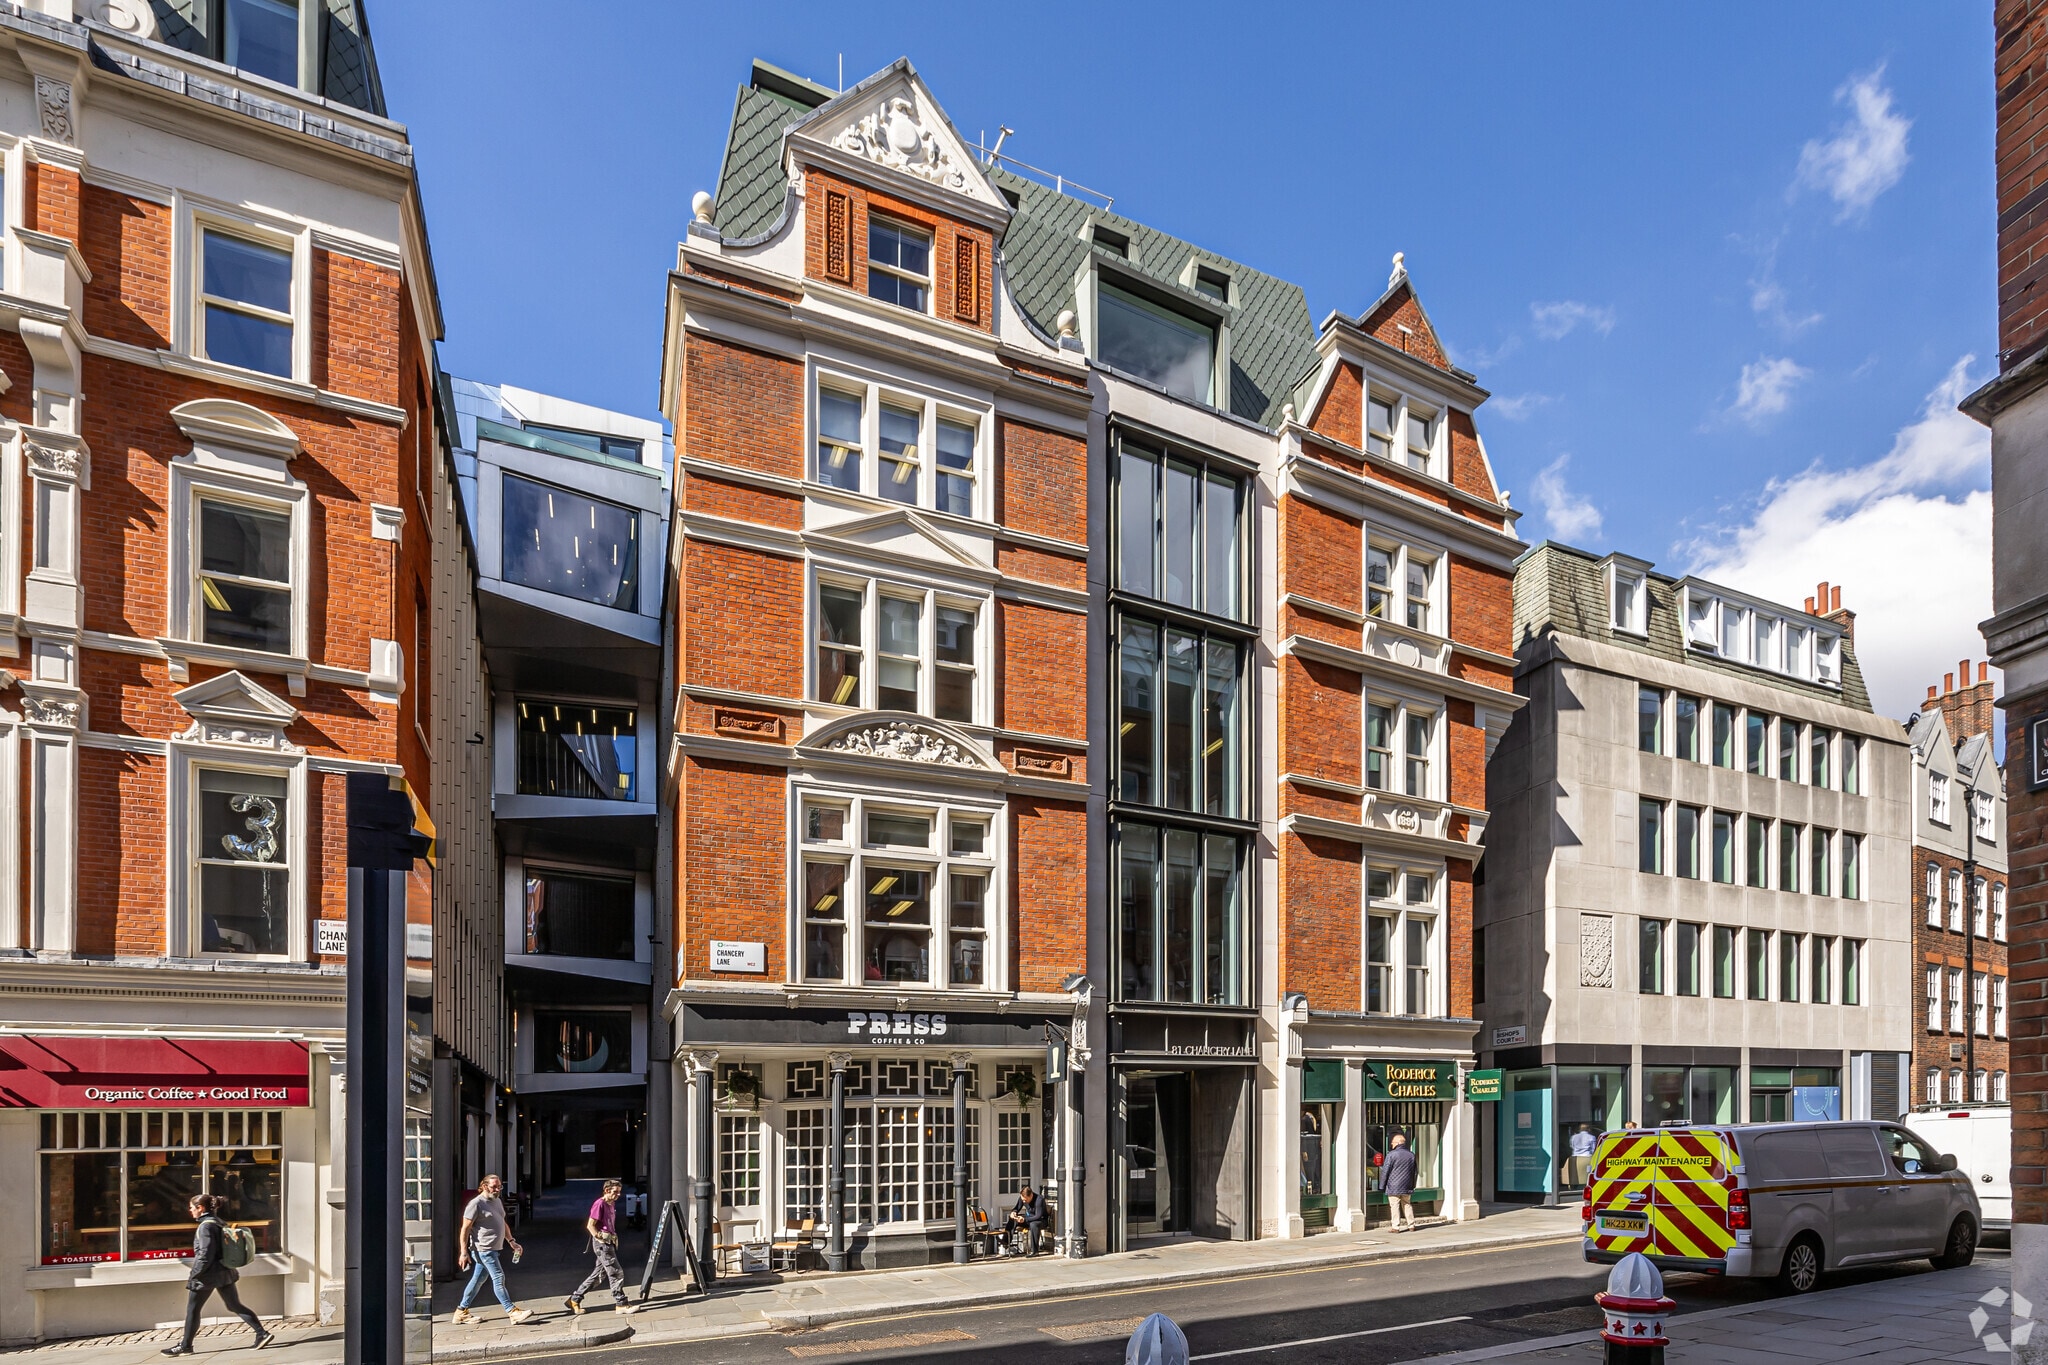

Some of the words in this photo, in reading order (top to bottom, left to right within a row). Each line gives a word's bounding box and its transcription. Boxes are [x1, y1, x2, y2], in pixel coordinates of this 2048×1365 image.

[320, 942, 345, 952] LANE
[848, 1012, 947, 1035] PRESS
[1171, 1045, 1182, 1056] 81
[1386, 1063, 1437, 1081] RODERICK
[1470, 1078, 1500, 1086] RODERICK
[84, 1087, 144, 1102] Organic
[147, 1087, 195, 1100] Coffee
[209, 1087, 250, 1100] Good
[252, 1087, 288, 1100] Food
[1387, 1081, 1437, 1098] CHARLES
[1471, 1086, 1499, 1095] CHARLES
